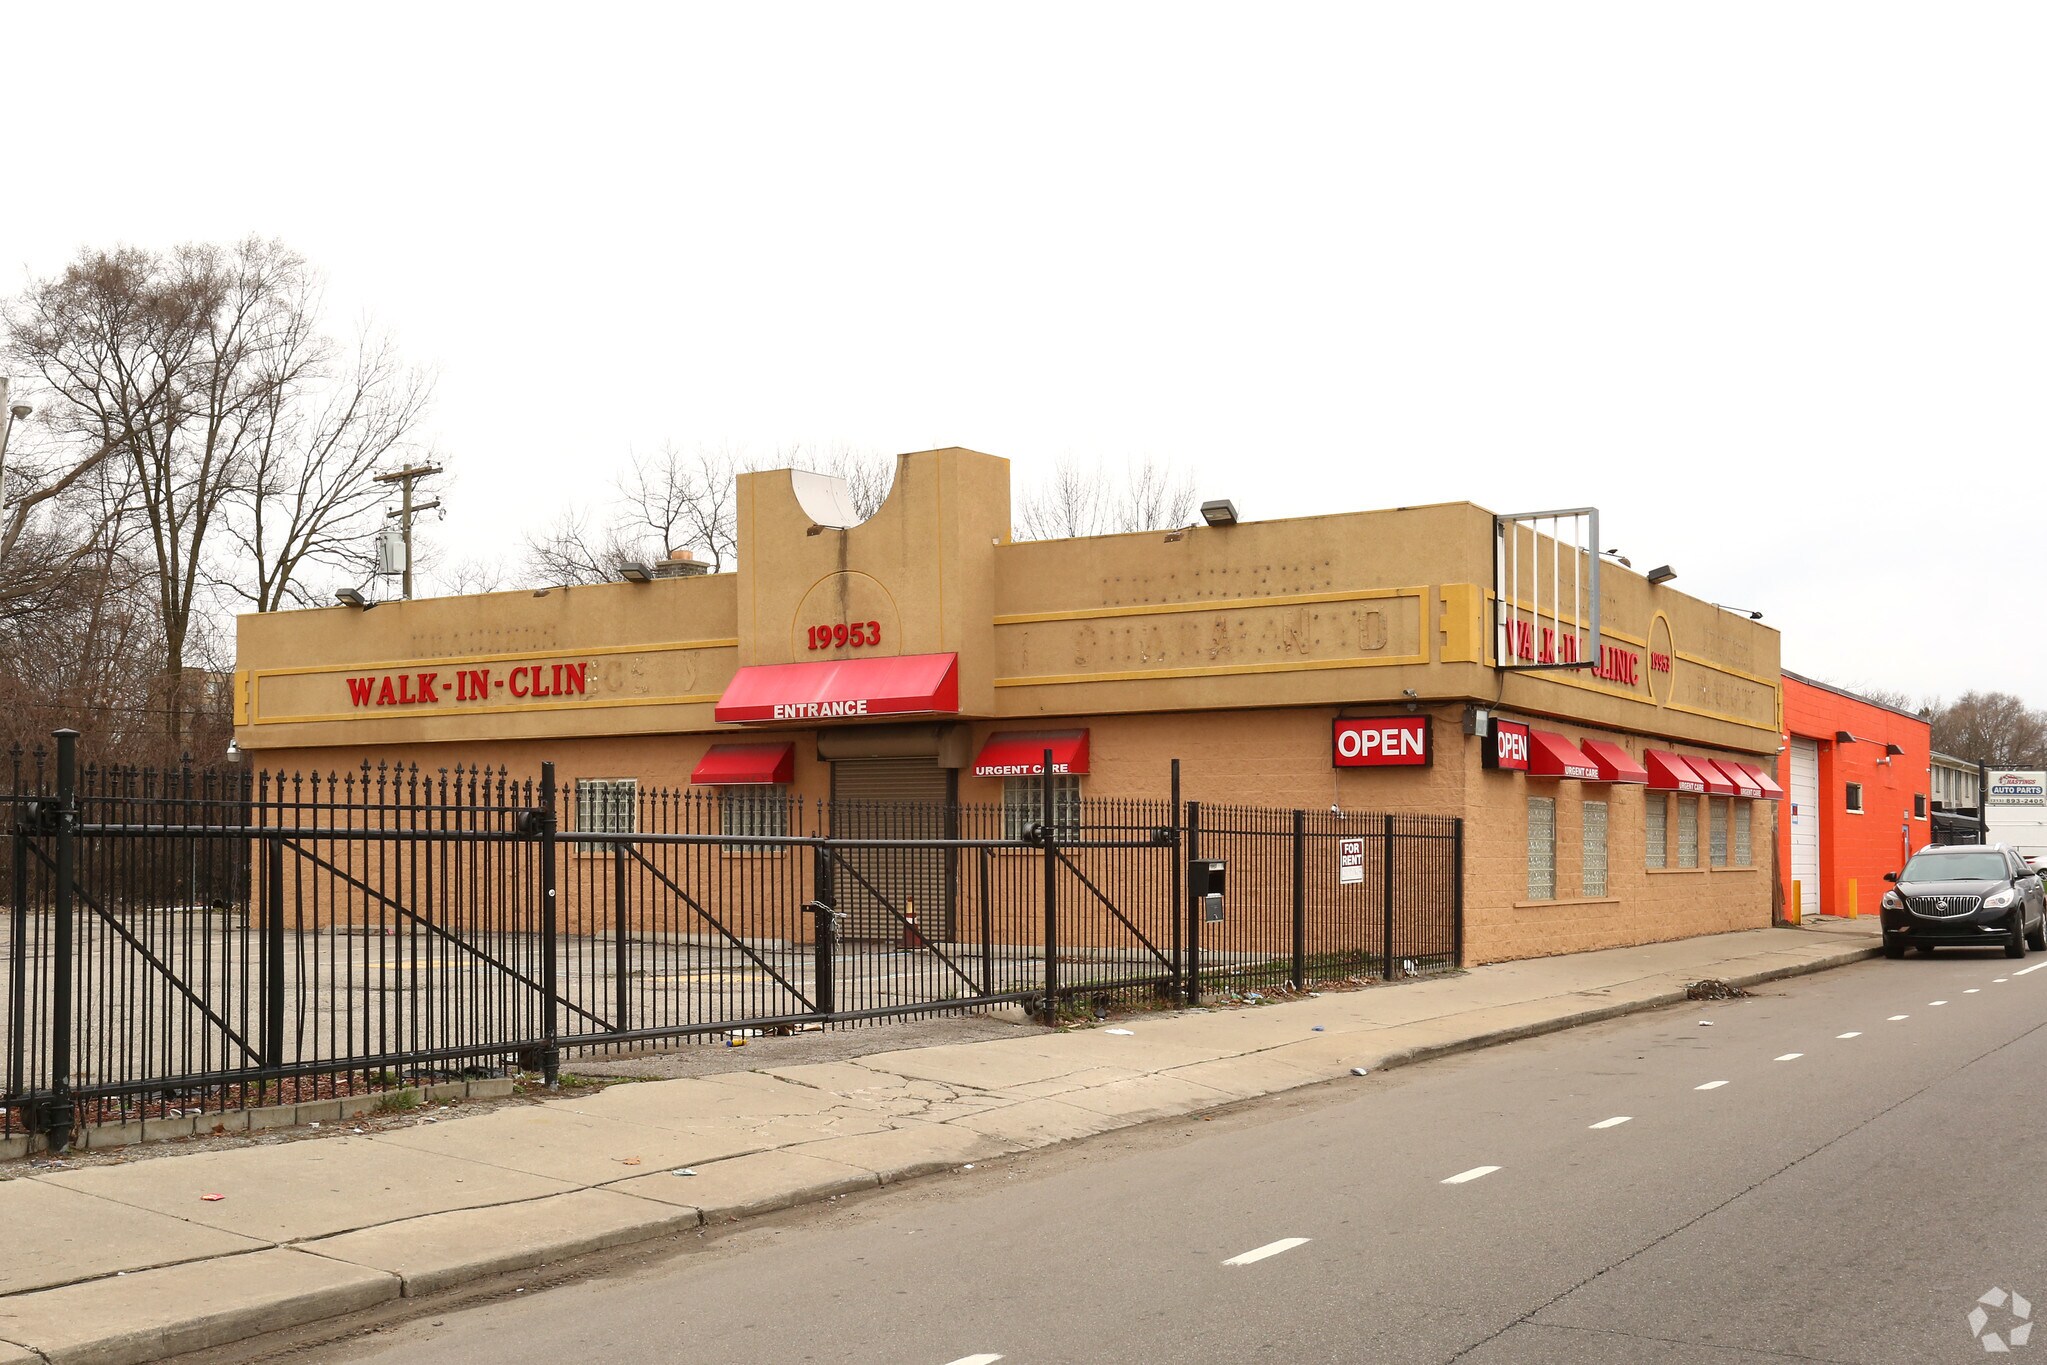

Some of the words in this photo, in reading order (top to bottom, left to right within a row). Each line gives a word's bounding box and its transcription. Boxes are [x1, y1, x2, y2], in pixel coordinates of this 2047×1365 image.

[807, 621, 881, 650] 19953
[1651, 651, 1670, 673] 19953
[773, 700, 868, 719] ENTRANCE
[1337, 727, 1424, 758] OPEN
[1498, 731, 1527, 761] OPEN
[975, 765, 1029, 775] URGENT
[1032, 764, 1069, 773] CRE
[1564, 766, 1585, 776] URGENT
[1586, 768, 1598, 778] CARE
[1679, 782, 1694, 790] URGENT
[1694, 783, 1704, 792] CARE
[1740, 788, 1752, 796] URGENT
[1752, 789, 1762, 797] CARE
[1344, 843, 1360, 854] FOR
[1342, 854, 1362, 866] RENT
